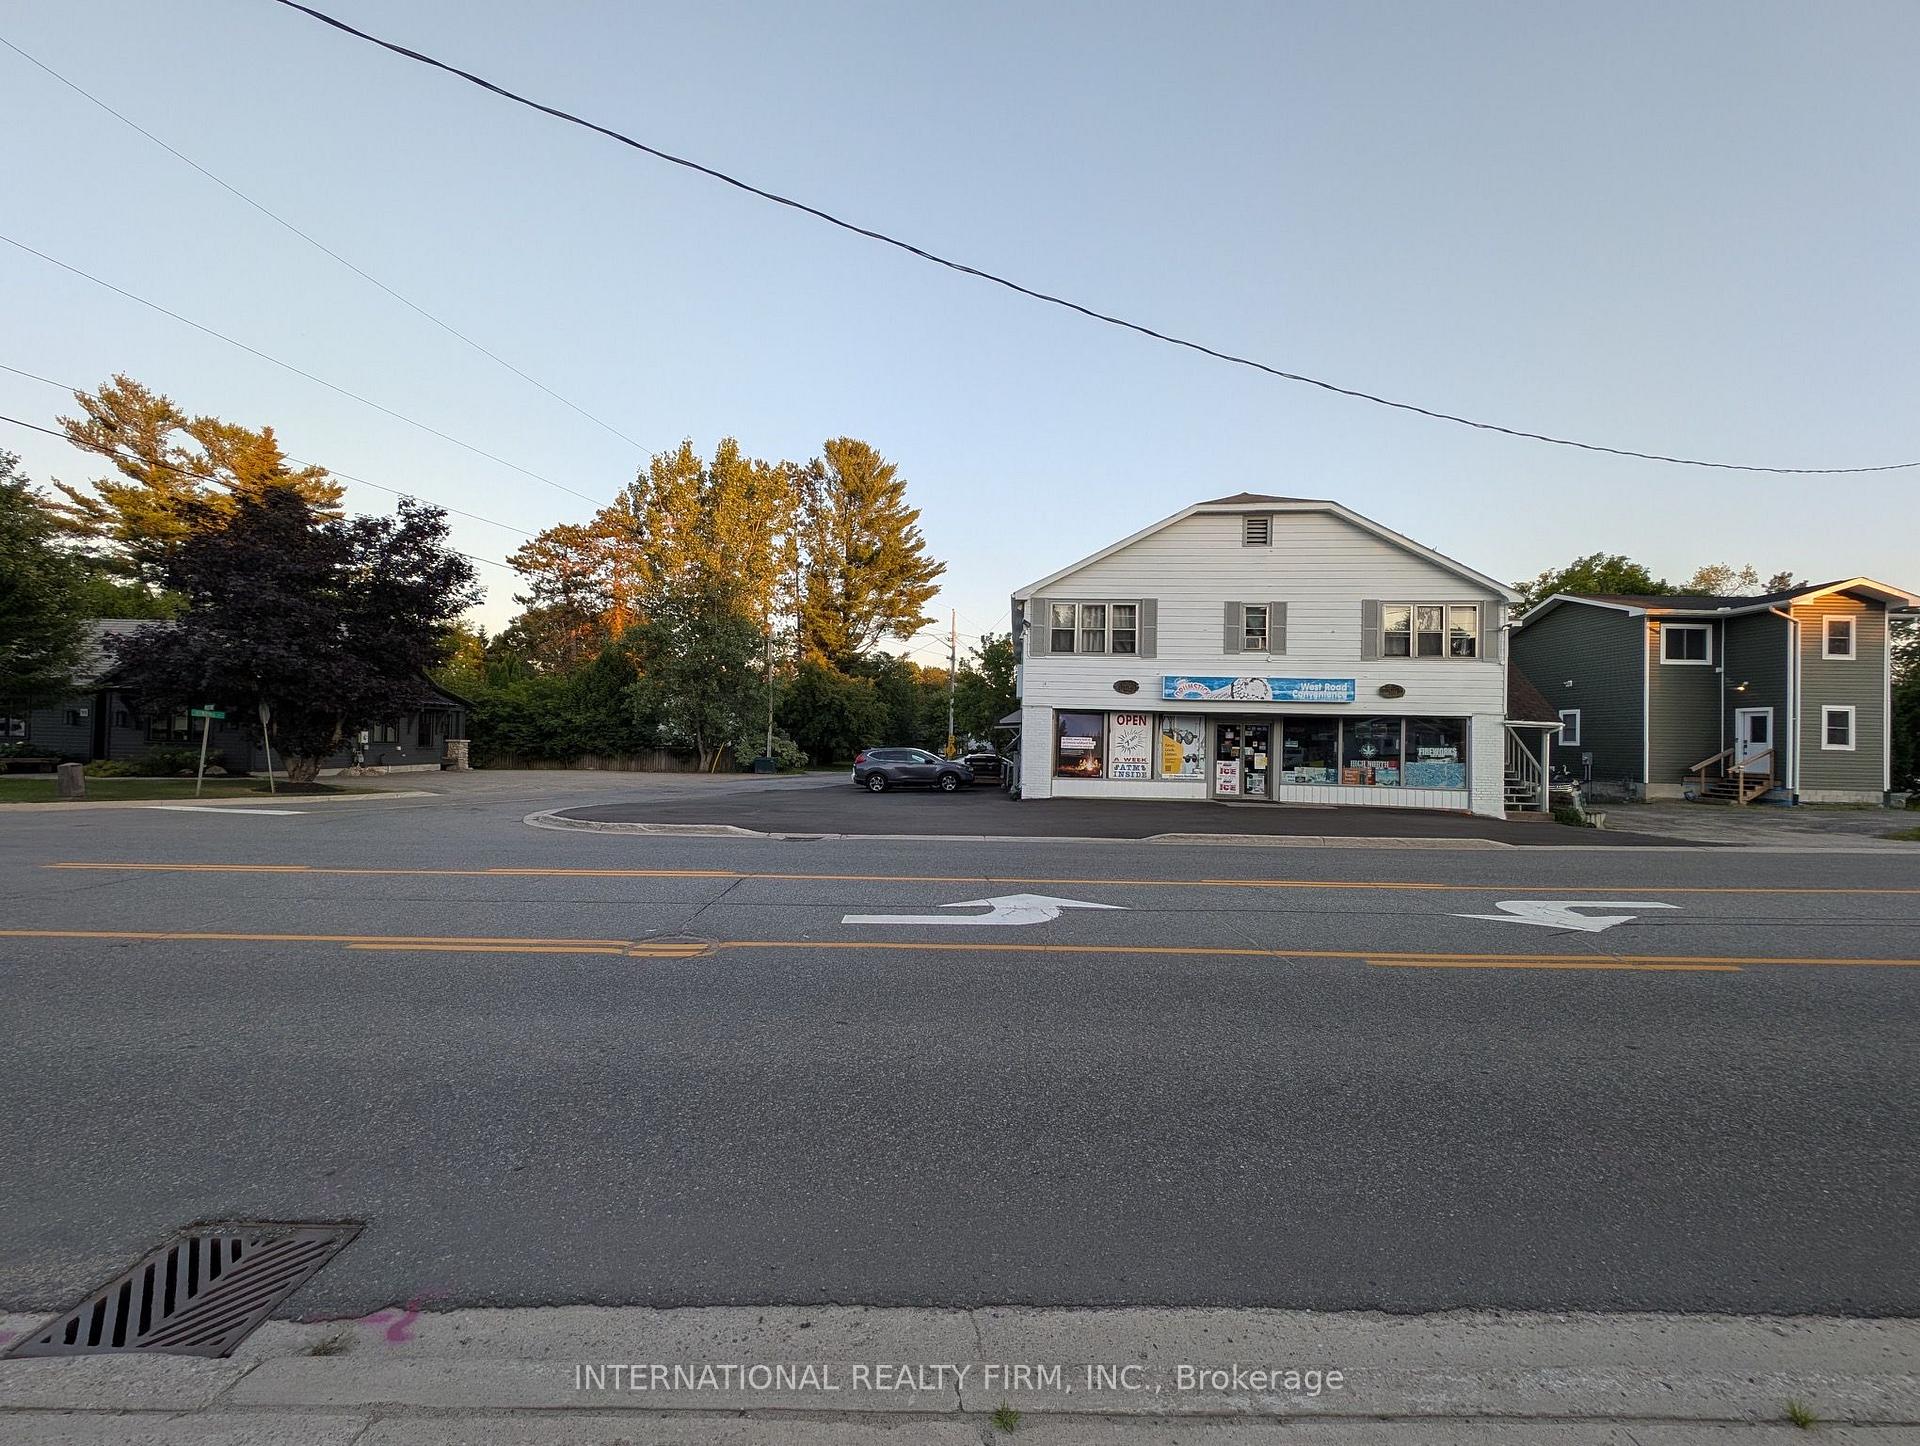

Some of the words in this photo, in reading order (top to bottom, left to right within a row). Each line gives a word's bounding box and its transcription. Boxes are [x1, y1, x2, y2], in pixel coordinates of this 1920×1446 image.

[1175, 683, 1210, 696] DRUMSTICK
[1300, 683, 1322, 691] West
[1324, 682, 1348, 691] Road
[1292, 690, 1348, 699] Convenience
[1117, 714, 1147, 726] OPEN
[1418, 747, 1458, 756] FIREWORKS
